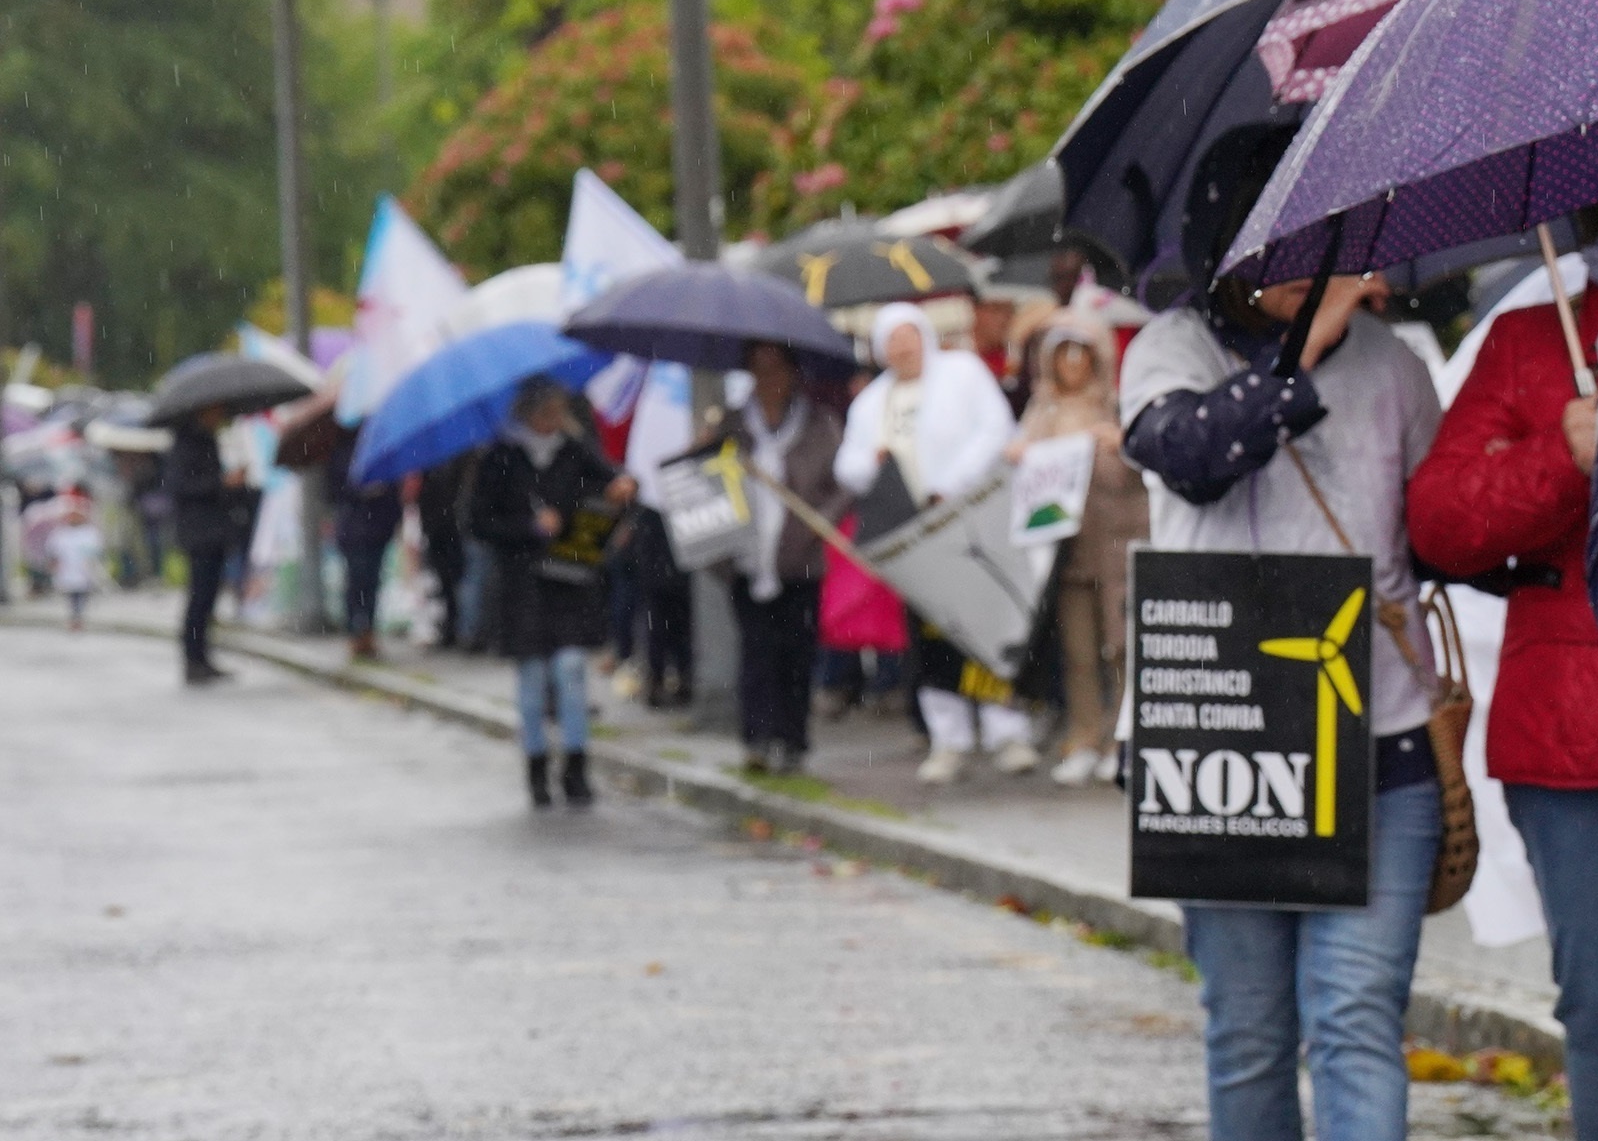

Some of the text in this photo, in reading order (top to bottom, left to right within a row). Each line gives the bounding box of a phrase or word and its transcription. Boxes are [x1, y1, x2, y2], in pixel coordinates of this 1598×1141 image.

[1141, 598, 1233, 628] CARBALLO
[1140, 667, 1252, 697] CORISTANCO
[1140, 701, 1266, 731] SANTA COMBA
[1139, 748, 1312, 818] NON
[1138, 813, 1226, 835] PARQUES
